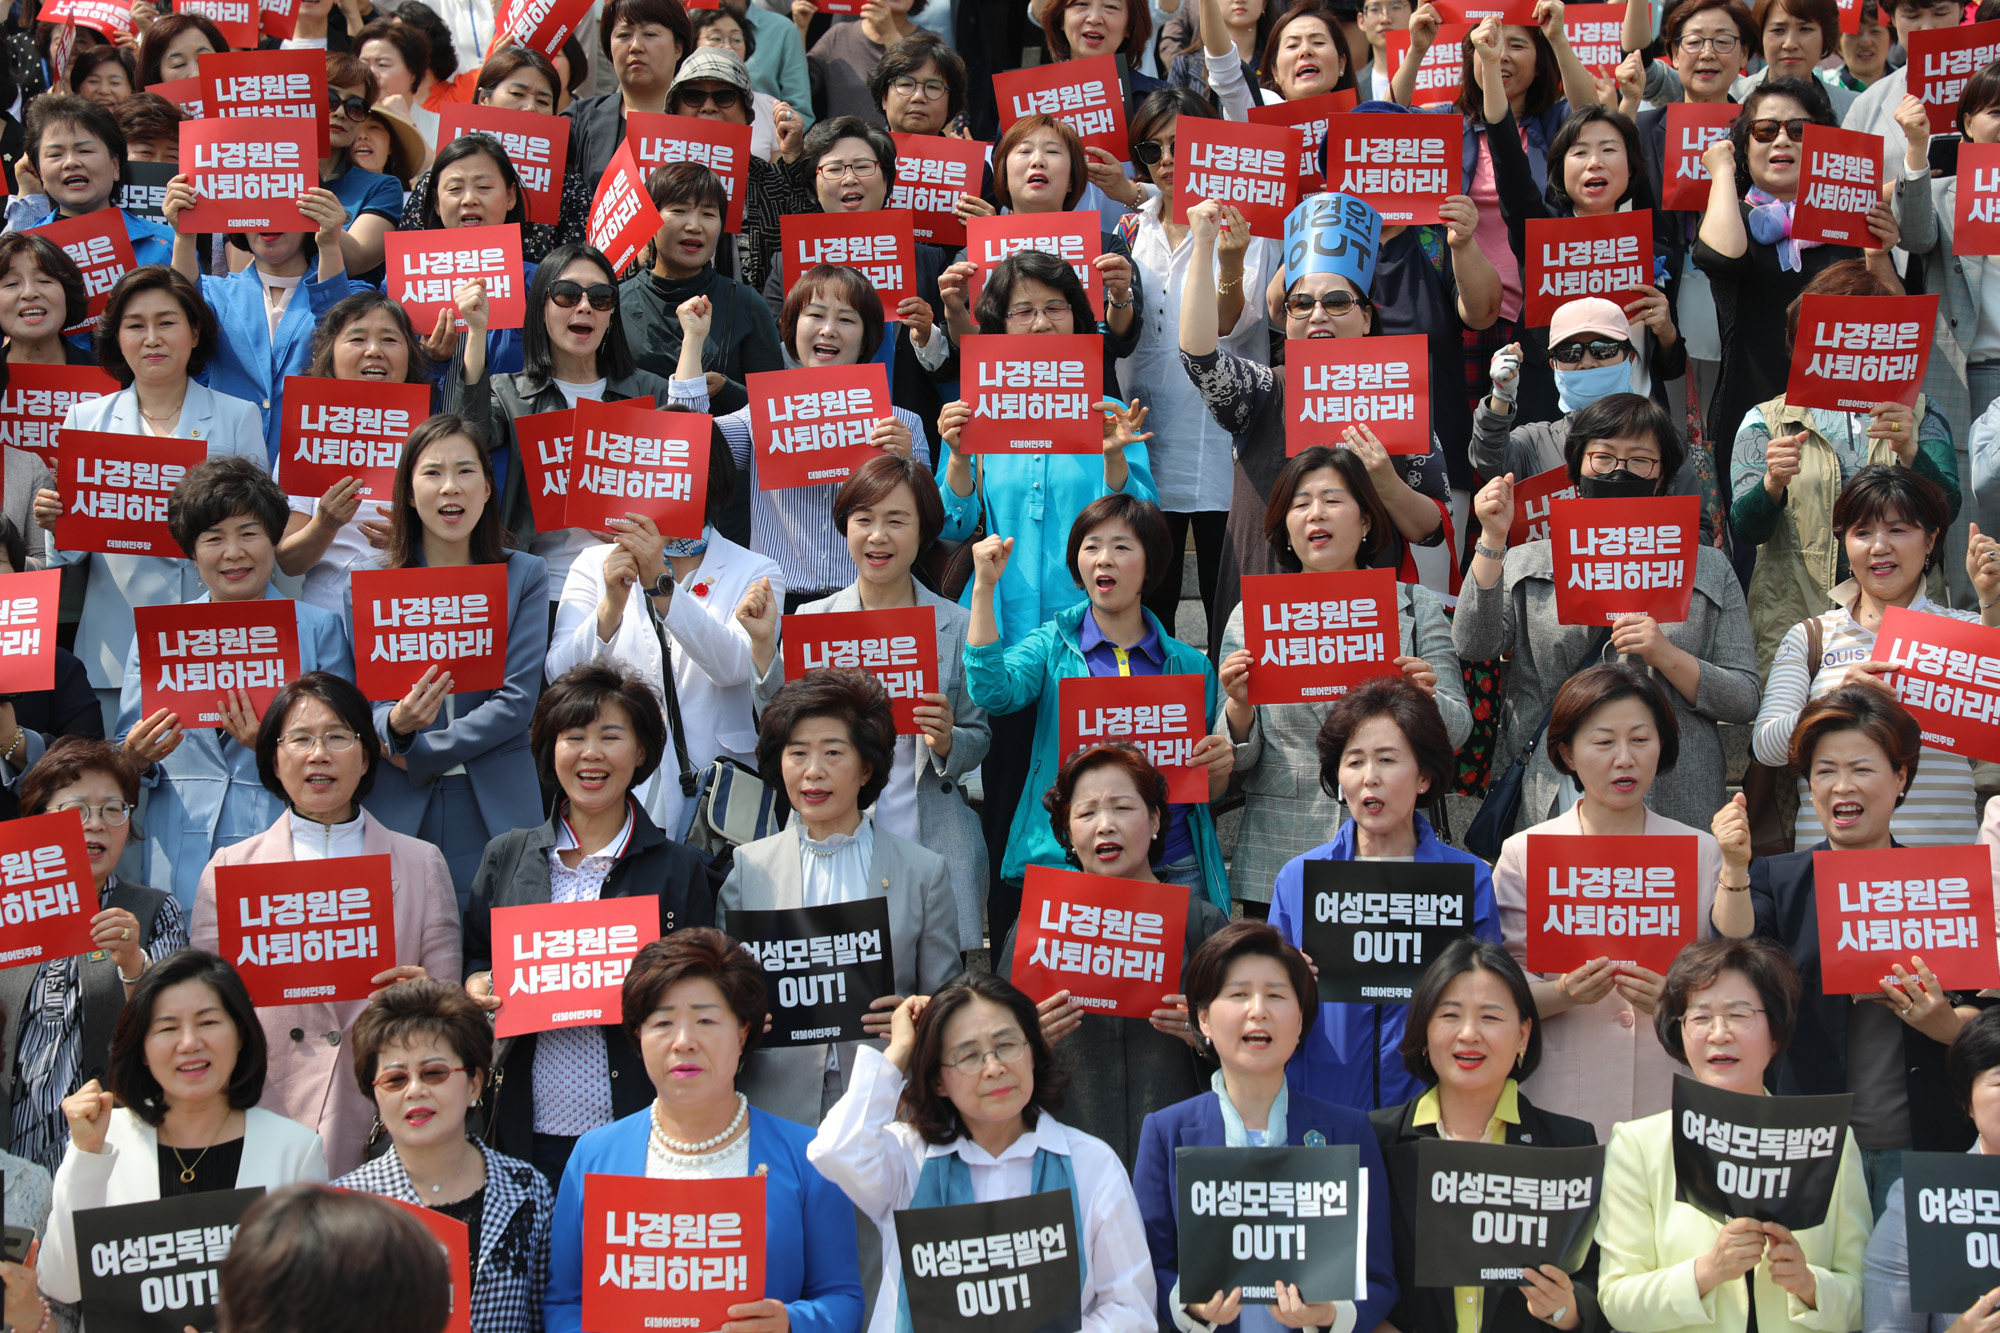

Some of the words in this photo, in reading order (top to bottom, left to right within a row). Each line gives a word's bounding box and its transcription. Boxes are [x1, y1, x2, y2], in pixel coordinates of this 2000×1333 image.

[1563, 22, 1620, 43] 나경원
[215, 74, 311, 102] 나경원은
[1013, 80, 1106, 121] 나경원은
[1060, 108, 1115, 137] 하라!
[195, 142, 299, 168] 나경원은
[640, 137, 734, 172] 나경원은
[1190, 142, 1285, 176] 나경원은
[1345, 138, 1445, 163] 나경원은
[890, 156, 967, 186] 경원은
[1340, 168, 1448, 193] 사퇴하라!
[1811, 151, 1874, 184] 나경원은
[193, 173, 304, 201] 사퇴하라!
[884, 185, 967, 214] 퇴하라
[1185, 172, 1286, 210] 사퇴하라!
[228, 219, 270, 227] 더불어민주당
[1289, 197, 1374, 243] 나경원
[62, 236, 116, 268] 원은
[403, 248, 505, 275] 나경원은
[799, 235, 897, 263] 나경원은
[1288, 231, 1372, 272] OUT
[1543, 236, 1638, 267] 나경원은
[401, 275, 510, 303] 사퇴라!
[1815, 322, 1919, 350] 나경원은
[979, 361, 1084, 387] 나경원은
[1304, 362, 1410, 391] 나경원은
[1805, 353, 1918, 382] 사퇴하라!
[301, 405, 409, 437] 나경원은
[767, 388, 873, 422] 나경원은
[974, 393, 1088, 419] 사퇴하라!
[1300, 394, 1414, 423] 사퇴하라!
[294, 437, 403, 469] 사퇴하라
[585, 429, 690, 467] 나경원은
[1010, 440, 1053, 448] 더불어민주당
[77, 458, 187, 491] 나경원은
[578, 464, 692, 501] 사퇴하라!
[808, 467, 850, 479] 더불어민주당
[71, 490, 169, 522] 사퇴하라
[107, 540, 152, 550] 더불어민주당
[1570, 525, 1681, 556] 나경원은
[1568, 560, 1684, 590] 사퇴하라!
[373, 594, 489, 627] 나경원은
[1263, 598, 1378, 631] 나경원은
[158, 626, 278, 657] 나경원은
[370, 628, 493, 662] 사퇴하라!
[803, 636, 917, 672] 나경원은
[1261, 633, 1384, 666] 사퇴하라!
[157, 659, 284, 692] 사퇴하라!
[1301, 685, 1348, 696] 더불어민주당
[1078, 704, 1187, 736] 나경원은
[1920, 731, 1955, 746] 어민주당
[0, 845, 68, 886] 원은
[1549, 867, 1675, 898] 나경원은
[1838, 877, 1970, 913] 나경원은
[0, 881, 80, 927] 하라!
[239, 887, 371, 927] 나경원은
[1315, 892, 1463, 926] 여성모독발언
[1543, 904, 1680, 936] 사퇴하라!
[1039, 900, 1163, 945] 나경원은
[1837, 916, 1978, 951] 사퇴하라!
[237, 925, 378, 966] 사퇴하라!
[513, 925, 638, 961] 나경원은
[1353, 931, 1422, 964] OUT!
[1029, 937, 1165, 983] 사퇴하라!
[284, 985, 336, 998] 더불어민주당
[510, 958, 632, 996] 사퇴하라
[778, 972, 846, 1008] OUT!
[1361, 987, 1413, 998] 더불어민주당
[552, 1009, 602, 1022] 더불어민주당
[791, 1026, 841, 1040] 더불어민주당
[1683, 1110, 1837, 1161] 여성모독발언
[1432, 1171, 1592, 1210] 여성모독발언
[1717, 1161, 1791, 1199] OUT!
[1191, 1180, 1347, 1217] 여성모독발언
[1919, 1188, 2000, 1225] 여성모
[606, 1211, 742, 1249] 나경원은
[1233, 1224, 1305, 1260] OUT!
[1472, 1211, 1548, 1247] OUT!
[91, 1224, 240, 1277] 여성모독발
[912, 1223, 1067, 1277] 여성모독발언
[600, 1254, 747, 1291] 사퇴하라!
[1481, 1268, 1524, 1280] 더불어민주
[956, 1273, 1031, 1317] OUT!
[1242, 1285, 1278, 1299] 더불어민
[644, 1317, 700, 1328] 더불어민주당
